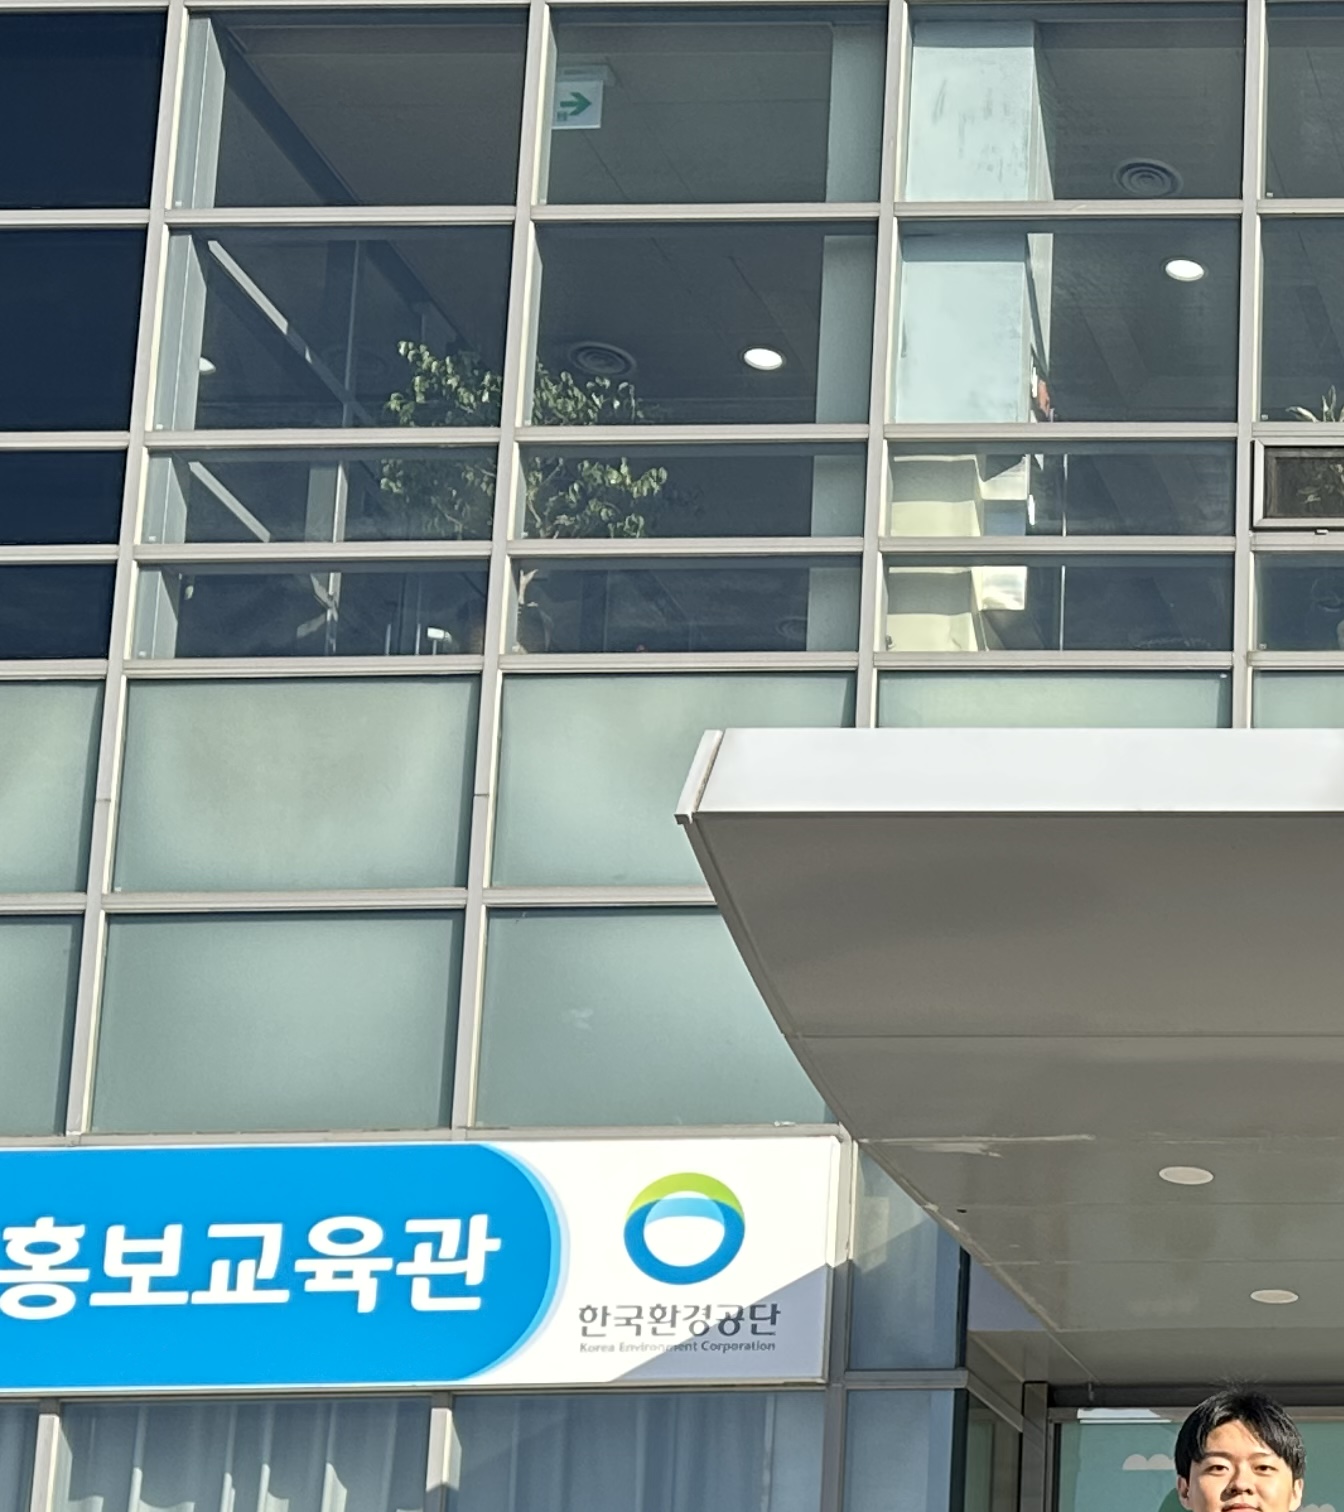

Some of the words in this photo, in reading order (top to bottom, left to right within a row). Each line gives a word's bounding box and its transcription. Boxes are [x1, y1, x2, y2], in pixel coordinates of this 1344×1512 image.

[0, 1213, 502, 1321] 홍보교육관
[578, 1303, 782, 1337] 한국환경공단
[579, 1342, 615, 1353] Korea
[619, 1341, 698, 1353] Environment
[701, 1340, 776, 1353] Corporation
